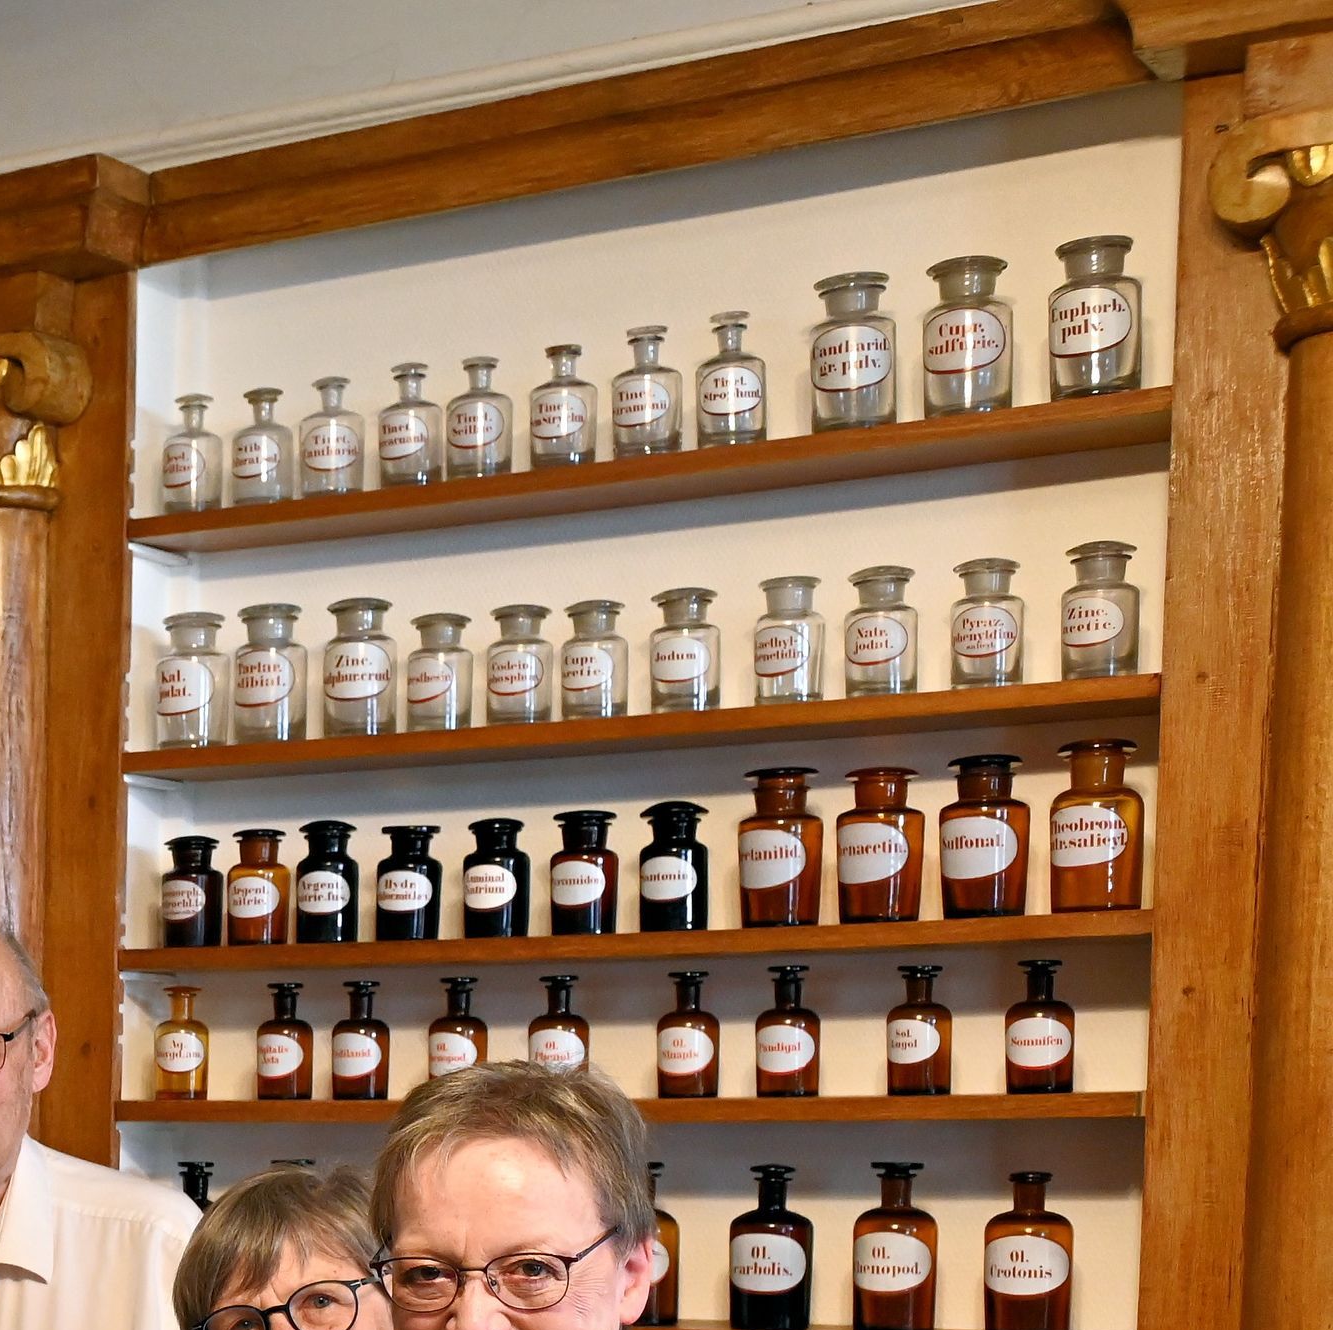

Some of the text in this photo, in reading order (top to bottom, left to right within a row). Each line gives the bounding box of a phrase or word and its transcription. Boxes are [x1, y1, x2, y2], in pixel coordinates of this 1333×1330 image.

[1050, 298, 1126, 324] Euphorb.
[1061, 318, 1104, 344] pulv.
[713, 376, 747, 388] Tint.
[618, 390, 655, 402] Tinc.
[537, 402, 574, 414] Tinc.
[455, 411, 493, 424] Tint.
[1067, 605, 1108, 621] Zinc.
[335, 655, 373, 667] Zinc.
[654, 650, 696, 662] Jodum
[751, 1245, 771, 1260] Ol.
[872, 1246, 890, 1260] Ol.
[1010, 1250, 1029, 1263] Ol.
[990, 1265, 1053, 1280] Crotonis
